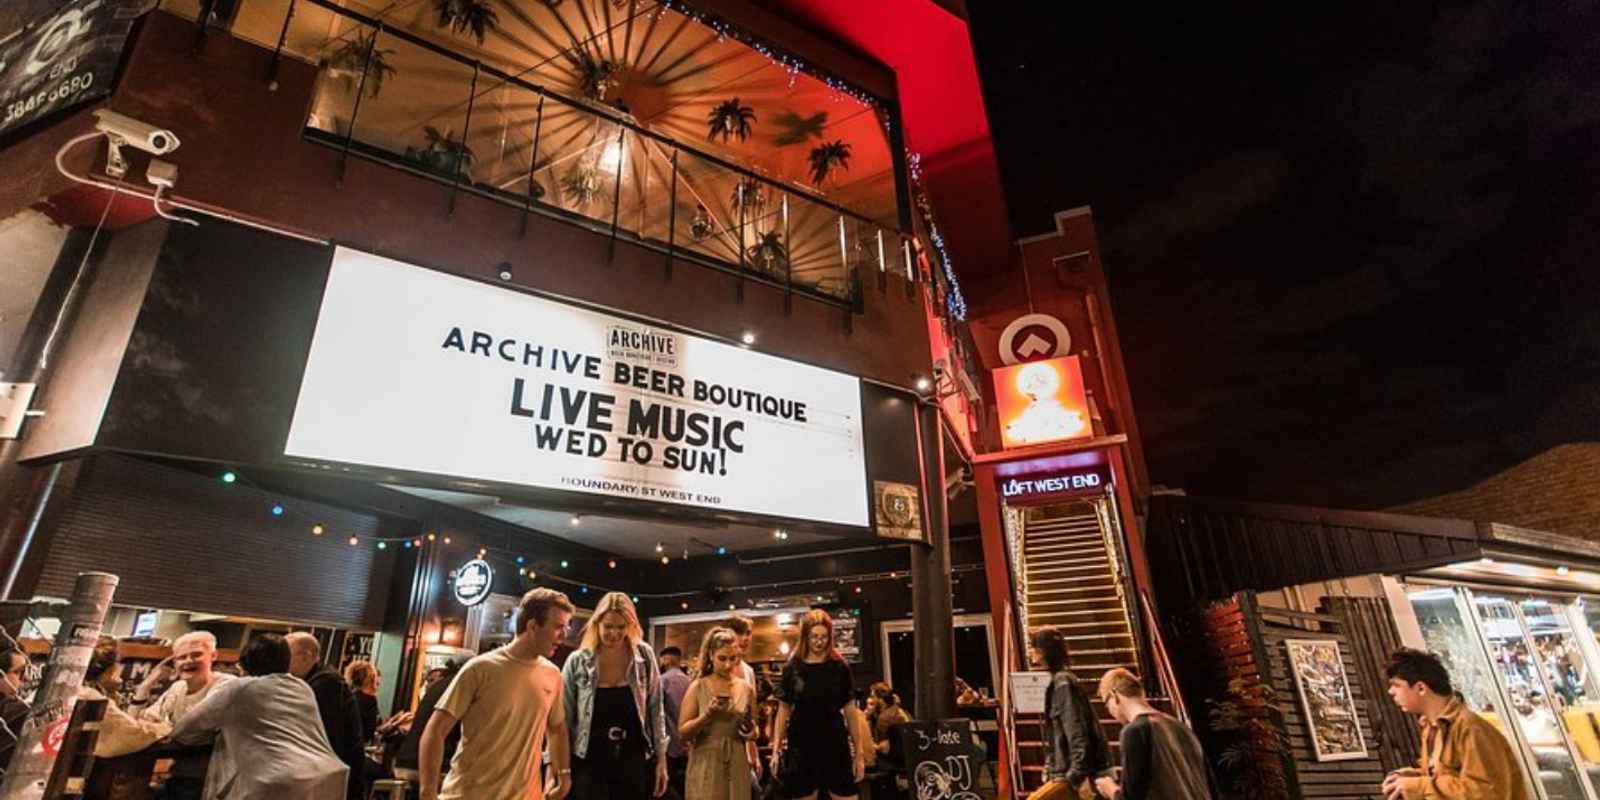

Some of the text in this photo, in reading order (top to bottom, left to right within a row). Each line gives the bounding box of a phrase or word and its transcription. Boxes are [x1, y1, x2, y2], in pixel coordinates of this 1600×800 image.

[611, 329, 674, 355] ARCHIVE
[442, 326, 807, 422] ARCHIVE BEER BOUTIQUE
[510, 377, 745, 453] LIVE MUSIC
[535, 423, 727, 476] WED TO SUN!
[641, 486, 657, 498] ST
[659, 489, 693, 502] WEST
[696, 494, 722, 505] END
[1034, 476, 1071, 493] WEST
[1071, 473, 1100, 489] END
[945, 754, 972, 790] DJ
